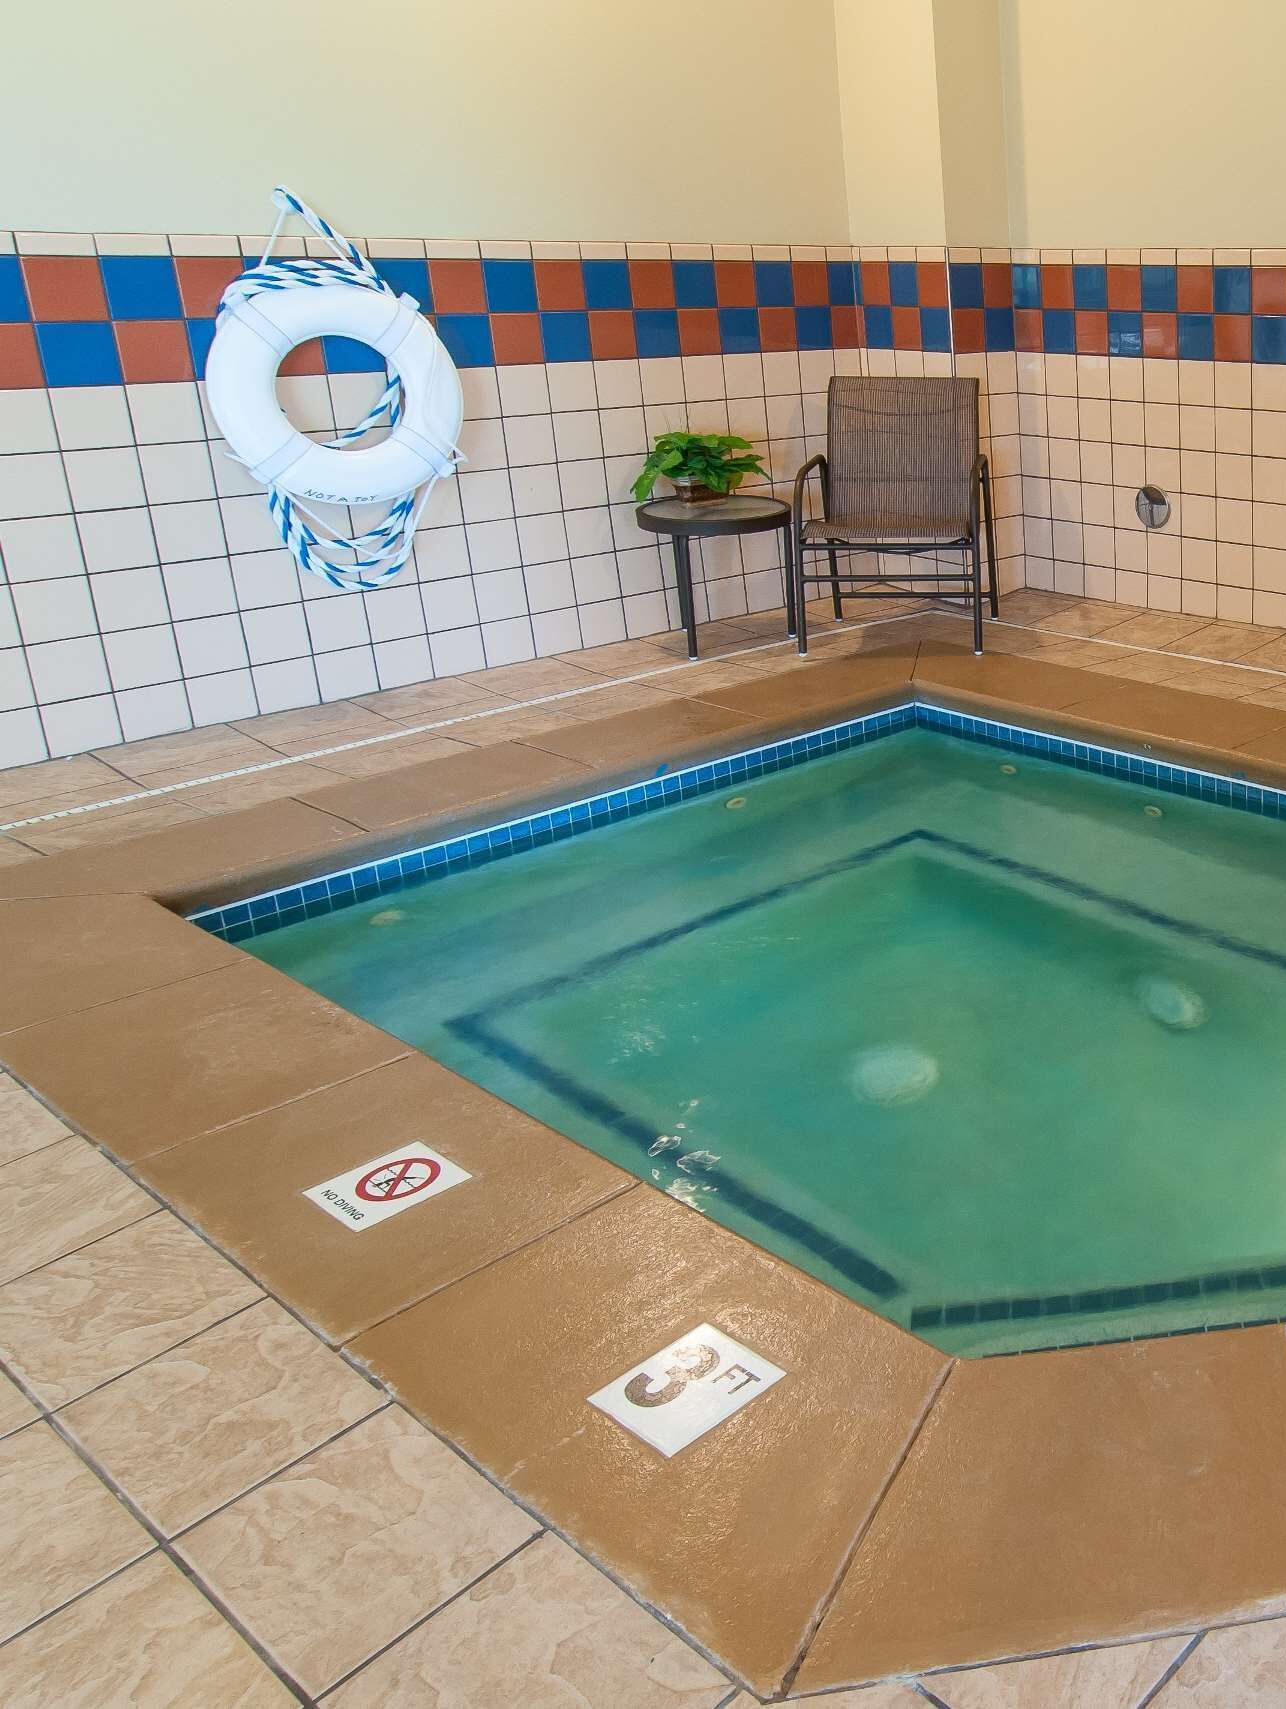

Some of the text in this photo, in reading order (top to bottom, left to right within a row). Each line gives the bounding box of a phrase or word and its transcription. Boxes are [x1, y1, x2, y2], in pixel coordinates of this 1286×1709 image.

[304, 489, 335, 500] NOT
[321, 1188, 364, 1221] NO DIVING
[624, 1344, 762, 1408] 3 FT
